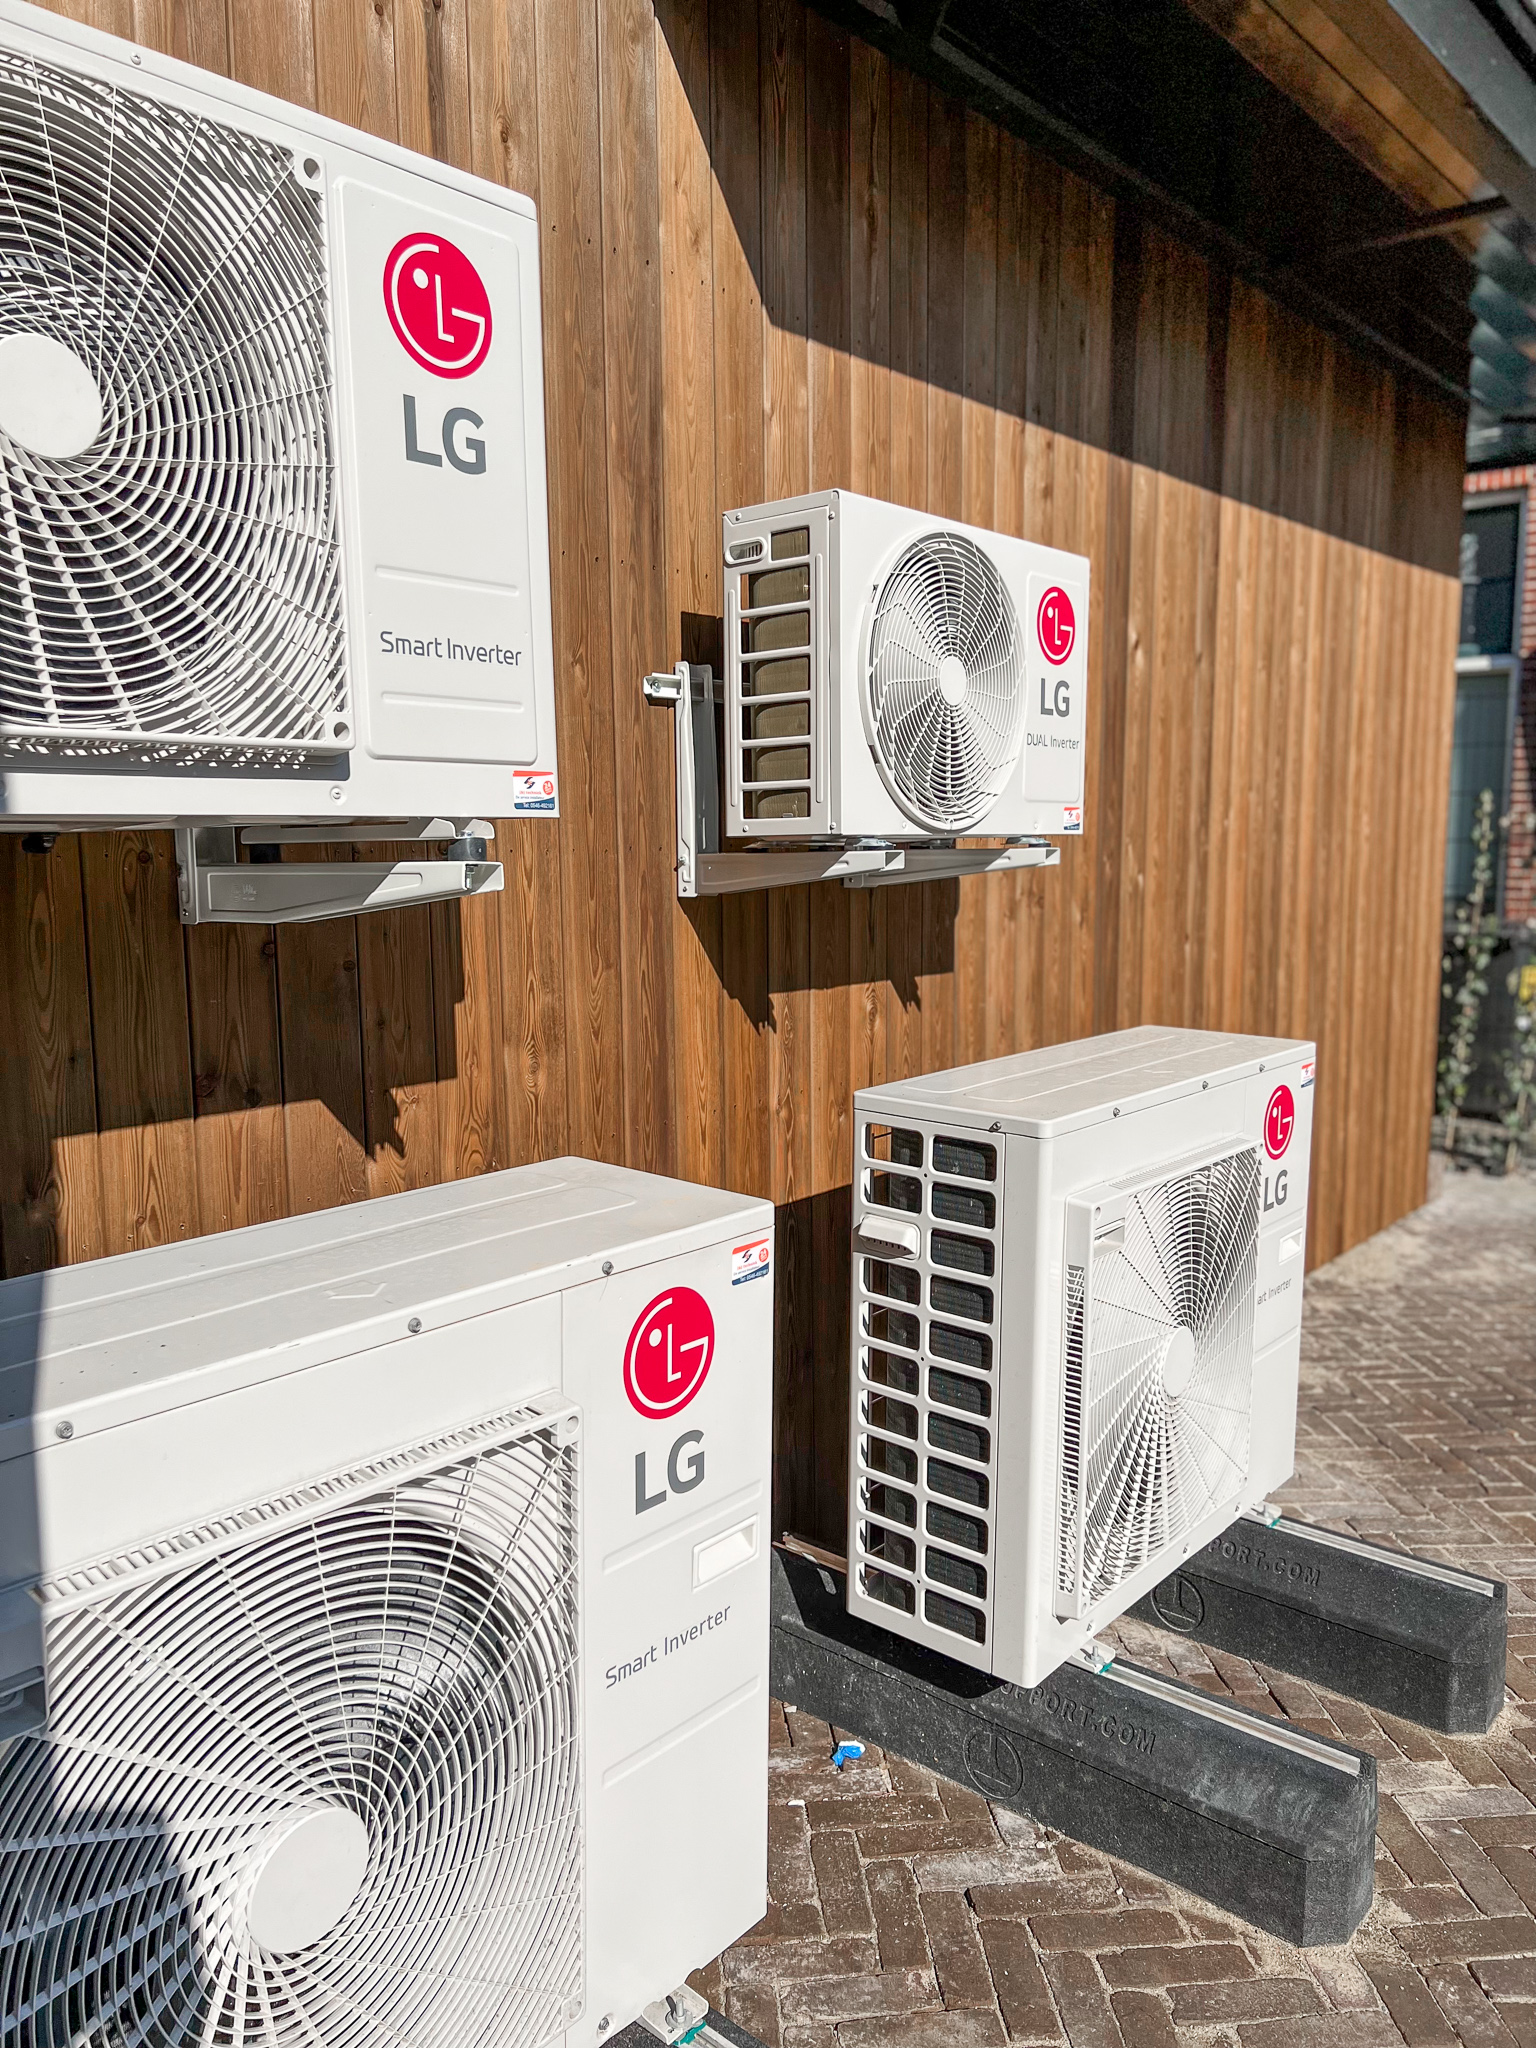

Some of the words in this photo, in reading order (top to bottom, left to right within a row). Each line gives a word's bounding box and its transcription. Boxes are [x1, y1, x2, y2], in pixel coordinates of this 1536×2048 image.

[403, 393, 487, 475] LG
[379, 631, 443, 659] Smart
[447, 637, 522, 667] Inverter
[1040, 677, 1070, 718] LG
[1027, 732, 1048, 748] DUAL
[1050, 734, 1080, 750] Inverter
[1263, 1169, 1288, 1213] LG
[1257, 1291, 1267, 1305] art
[1268, 1278, 1292, 1300] Inverter
[635, 1429, 706, 1516] LG
[1207, 1537, 1321, 1587] PORT.COM
[605, 1645, 658, 1689] Smart
[663, 1605, 731, 1657] Inverter
